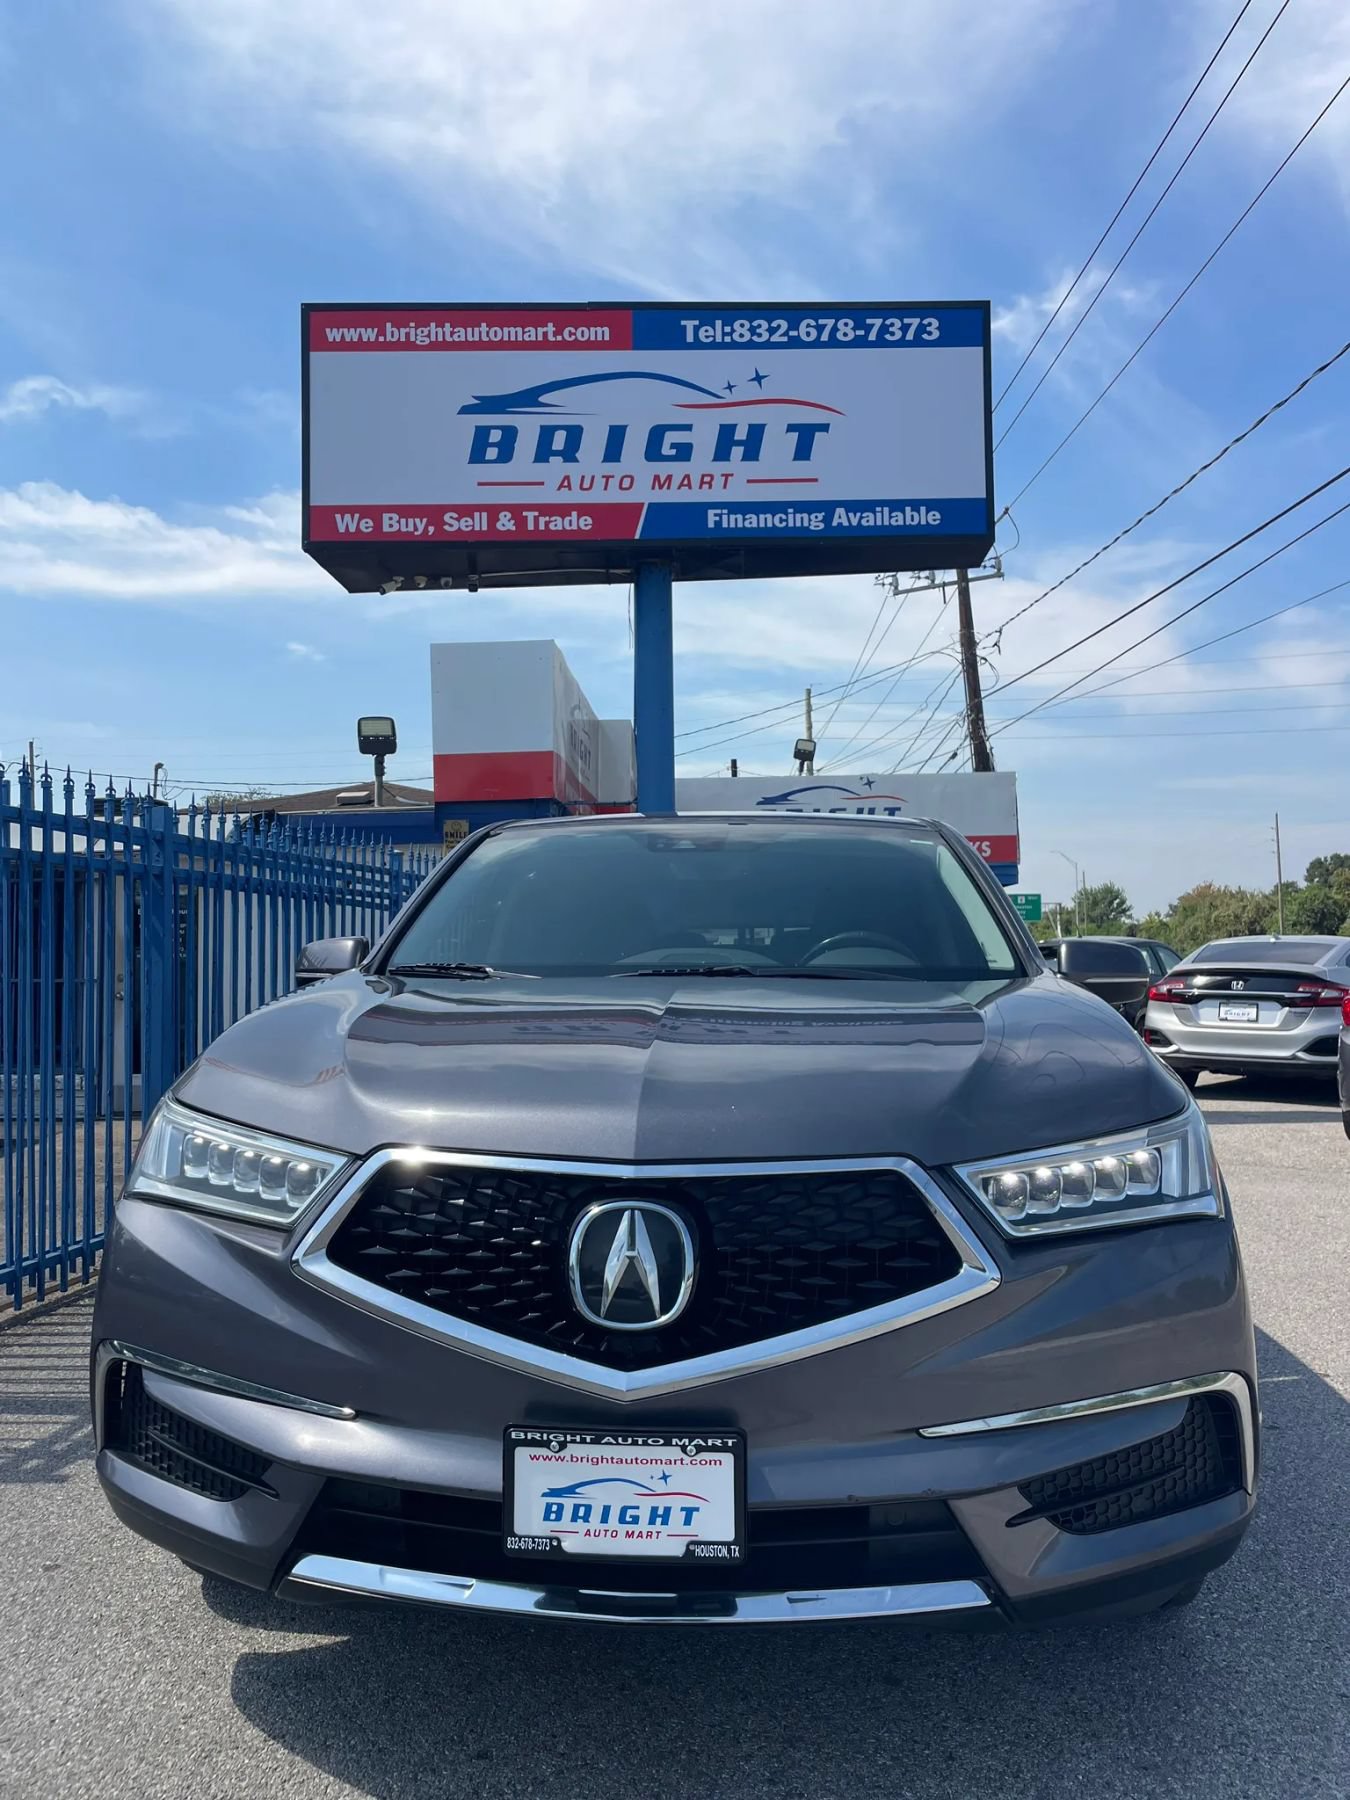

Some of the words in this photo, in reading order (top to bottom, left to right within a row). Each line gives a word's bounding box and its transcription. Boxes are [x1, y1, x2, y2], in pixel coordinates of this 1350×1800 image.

[325, 322, 610, 345] www.brightautomart.com
[681, 318, 940, 343] Tel:832-678-7373
[467, 423, 831, 465] BRIGHT
[556, 474, 635, 492] AUTO
[651, 473, 734, 491] MART
[335, 513, 374, 533] We
[382, 512, 435, 535] Buy,
[443, 511, 488, 532] Sell
[495, 511, 516, 531] &
[522, 511, 593, 531] Trade
[707, 508, 825, 530] Financing
[831, 506, 941, 527] Available
[511, 1431, 596, 1443] BRIGHT
[600, 1436, 665, 1446] AUTO
[671, 1438, 738, 1447] MART
[529, 1453, 723, 1467] www.brightautomart.com
[542, 1502, 701, 1527] BRIGHT
[506, 1536, 550, 1551] 832-678-7373
[583, 1528, 618, 1539] AUTO
[624, 1530, 662, 1540] MART
[695, 1544, 730, 1559] HOUSTON,
[730, 1545, 740, 1558] TX
